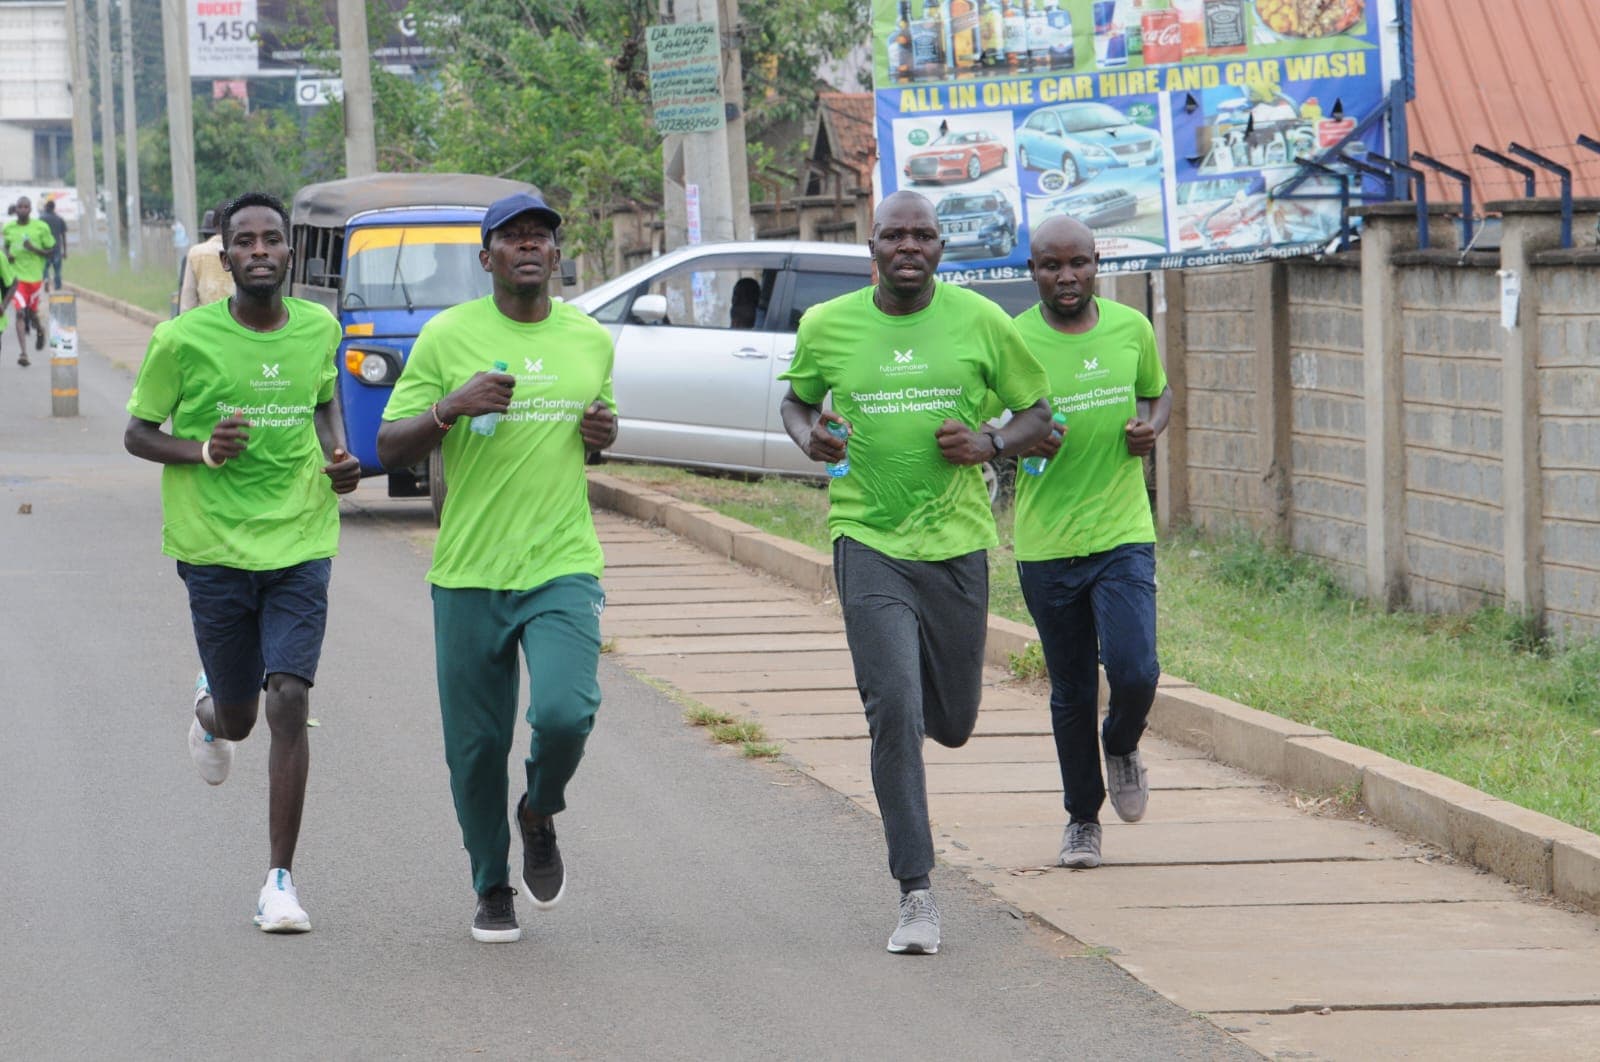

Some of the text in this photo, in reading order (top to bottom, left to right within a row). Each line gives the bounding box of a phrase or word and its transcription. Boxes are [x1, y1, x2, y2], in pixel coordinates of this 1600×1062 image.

[197, 21, 257, 44] 1,450
[900, 51, 1367, 113] ALL IN ONE CAR HIRE AND CAR WASH
[1121, 259, 1148, 271] 497
[933, 269, 986, 284] NTACT
[990, 266, 1018, 280] US:
[851, 386, 962, 401] Standard Chartered
[1053, 391, 1092, 405] Standard
[860, 399, 957, 415] Nairobi Marathon
[1058, 396, 1128, 414] Nairobi Marathon
